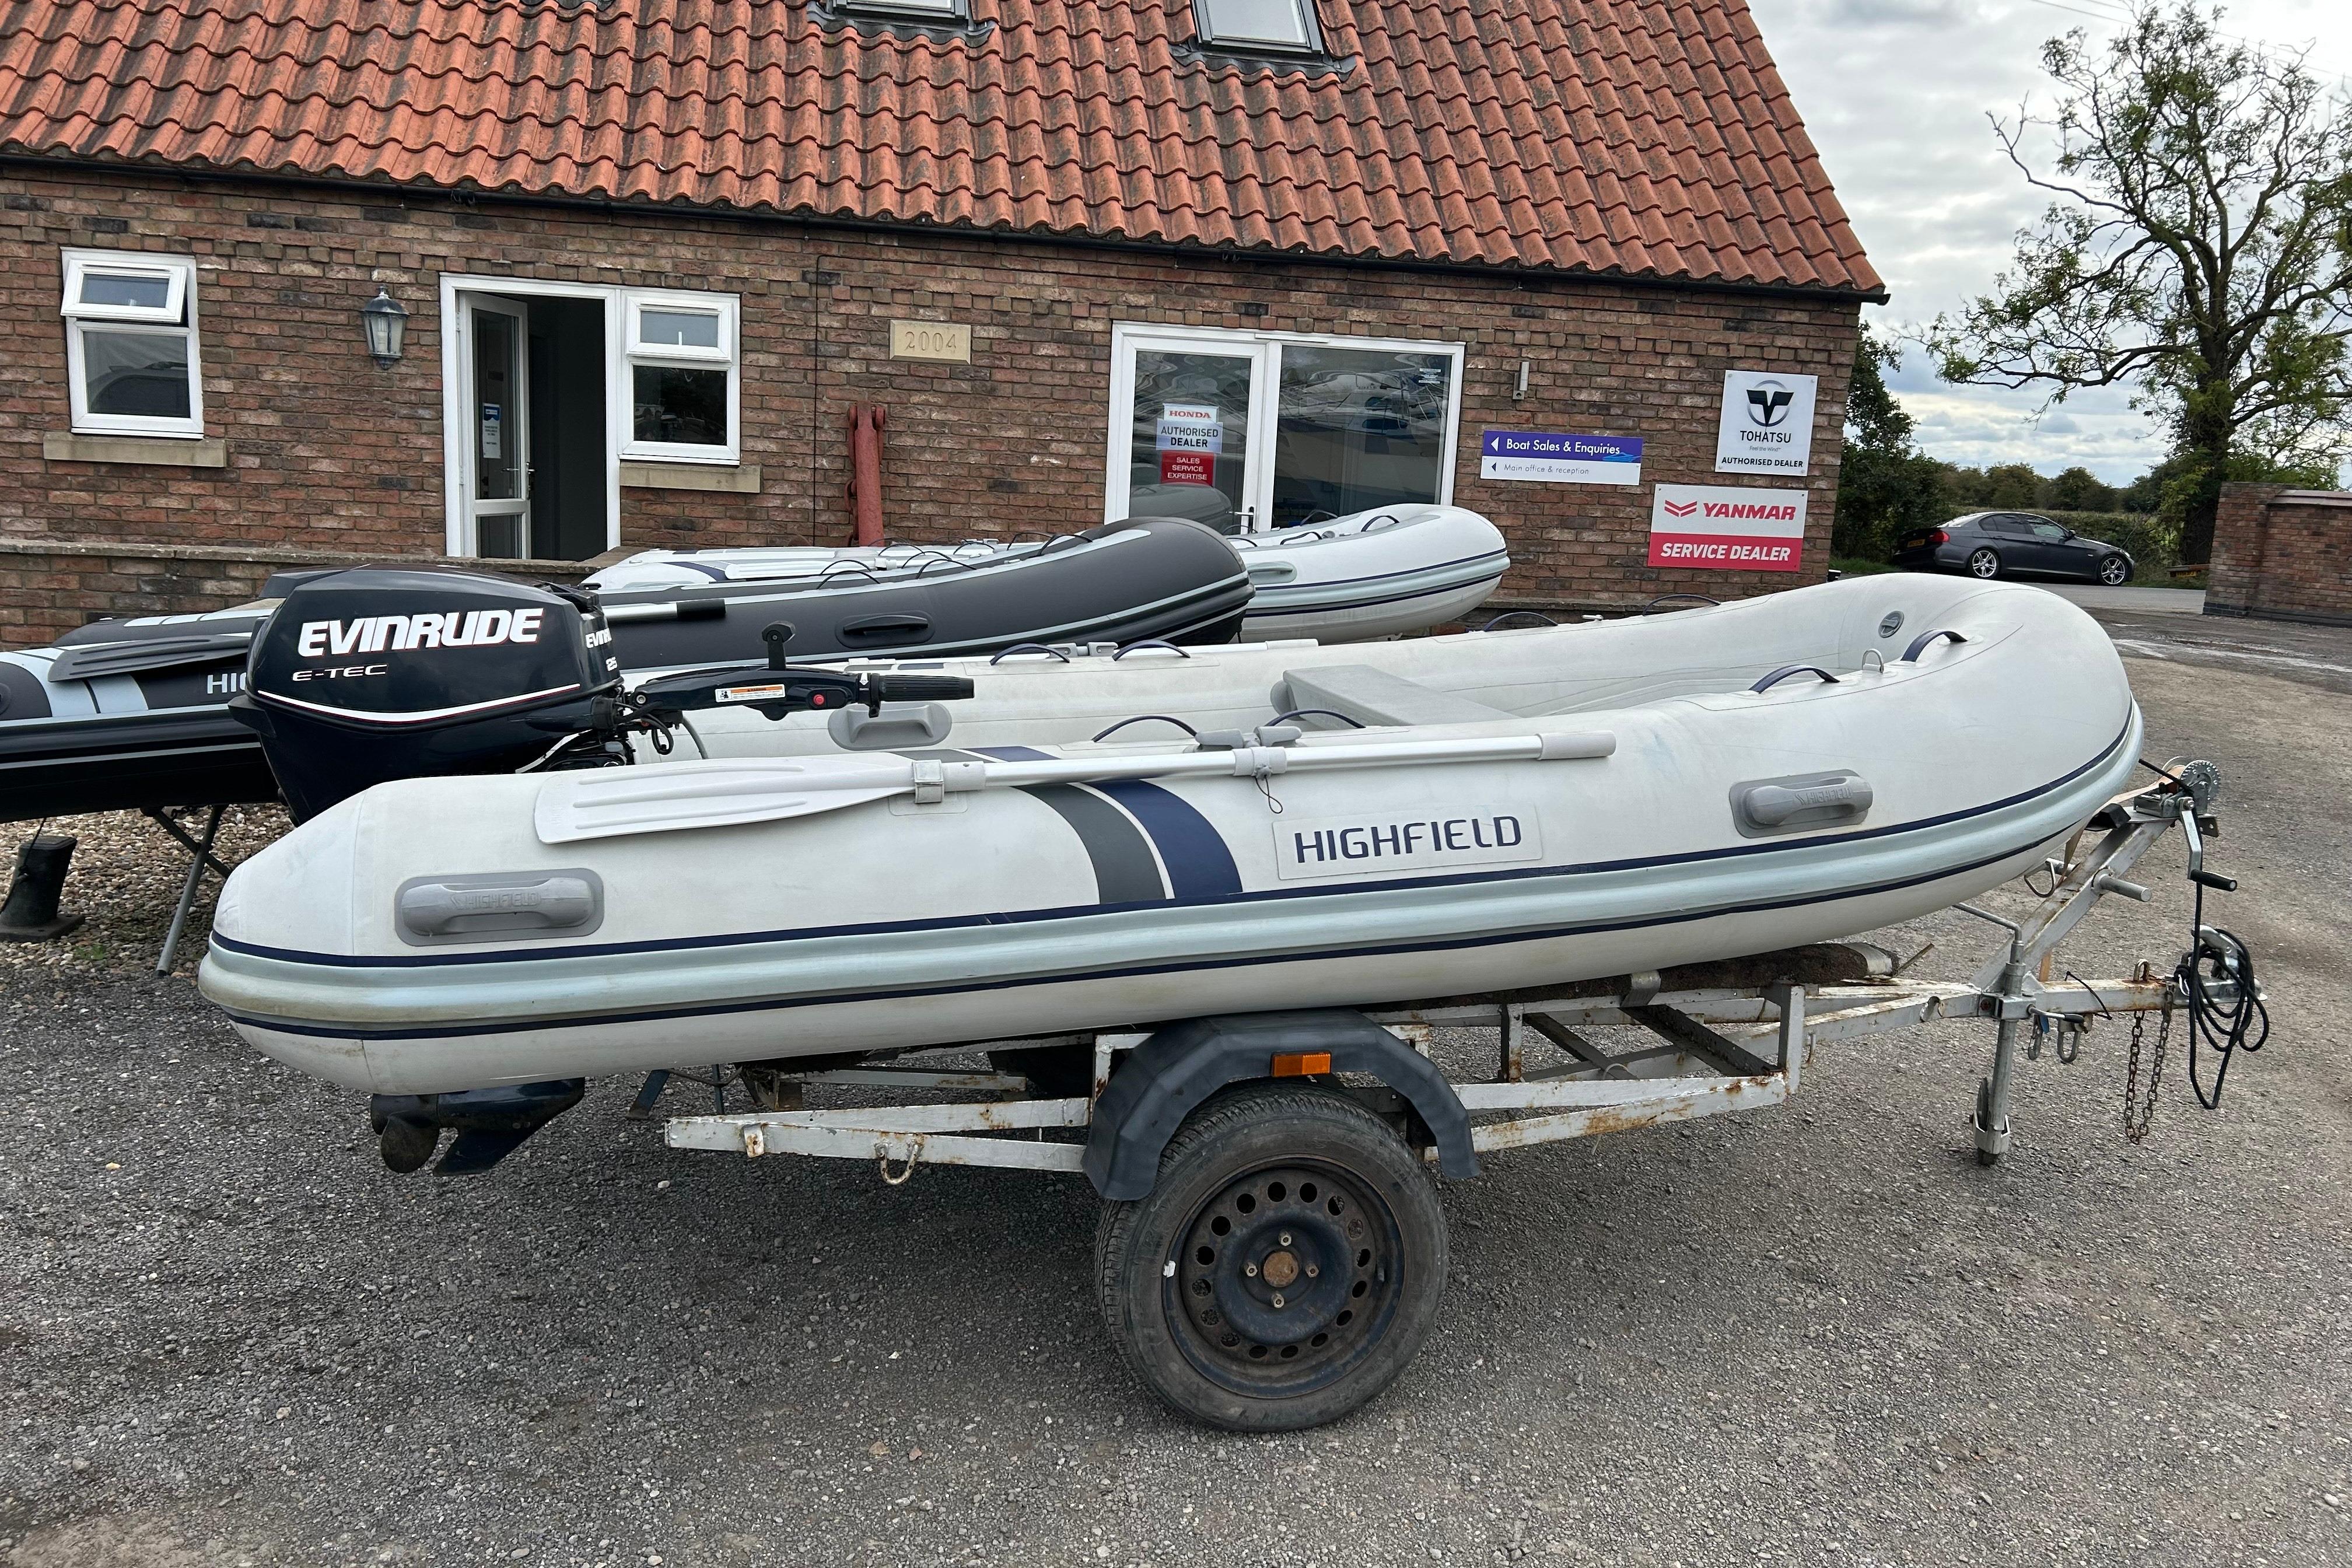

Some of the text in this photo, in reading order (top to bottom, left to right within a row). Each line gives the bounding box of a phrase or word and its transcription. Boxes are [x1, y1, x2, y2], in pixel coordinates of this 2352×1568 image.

[905, 331, 957, 353] 2004
[1161, 426, 1219, 437] AUTHORISED
[1740, 430, 1791, 443] TOHATSU
[1170, 437, 1208, 447] DEALER
[1506, 438, 1620, 456] Boat Sales & Enquiries
[1525, 464, 1545, 473] office
[1556, 467, 1589, 475] reception
[1721, 457, 1772, 466] AUTHORISED
[1167, 472, 1208, 480] EXPERTISE
[1703, 503, 1797, 520] YANMAR
[1660, 542, 1791, 561] SERVICE DEALER
[298, 608, 546, 658] EVINRUDE
[606, 656, 618, 671] 25
[292, 664, 388, 682] E-TEC
[1294, 816, 1521, 863] HIGHFIELD
[466, 892, 541, 909] HIGHFIELD
